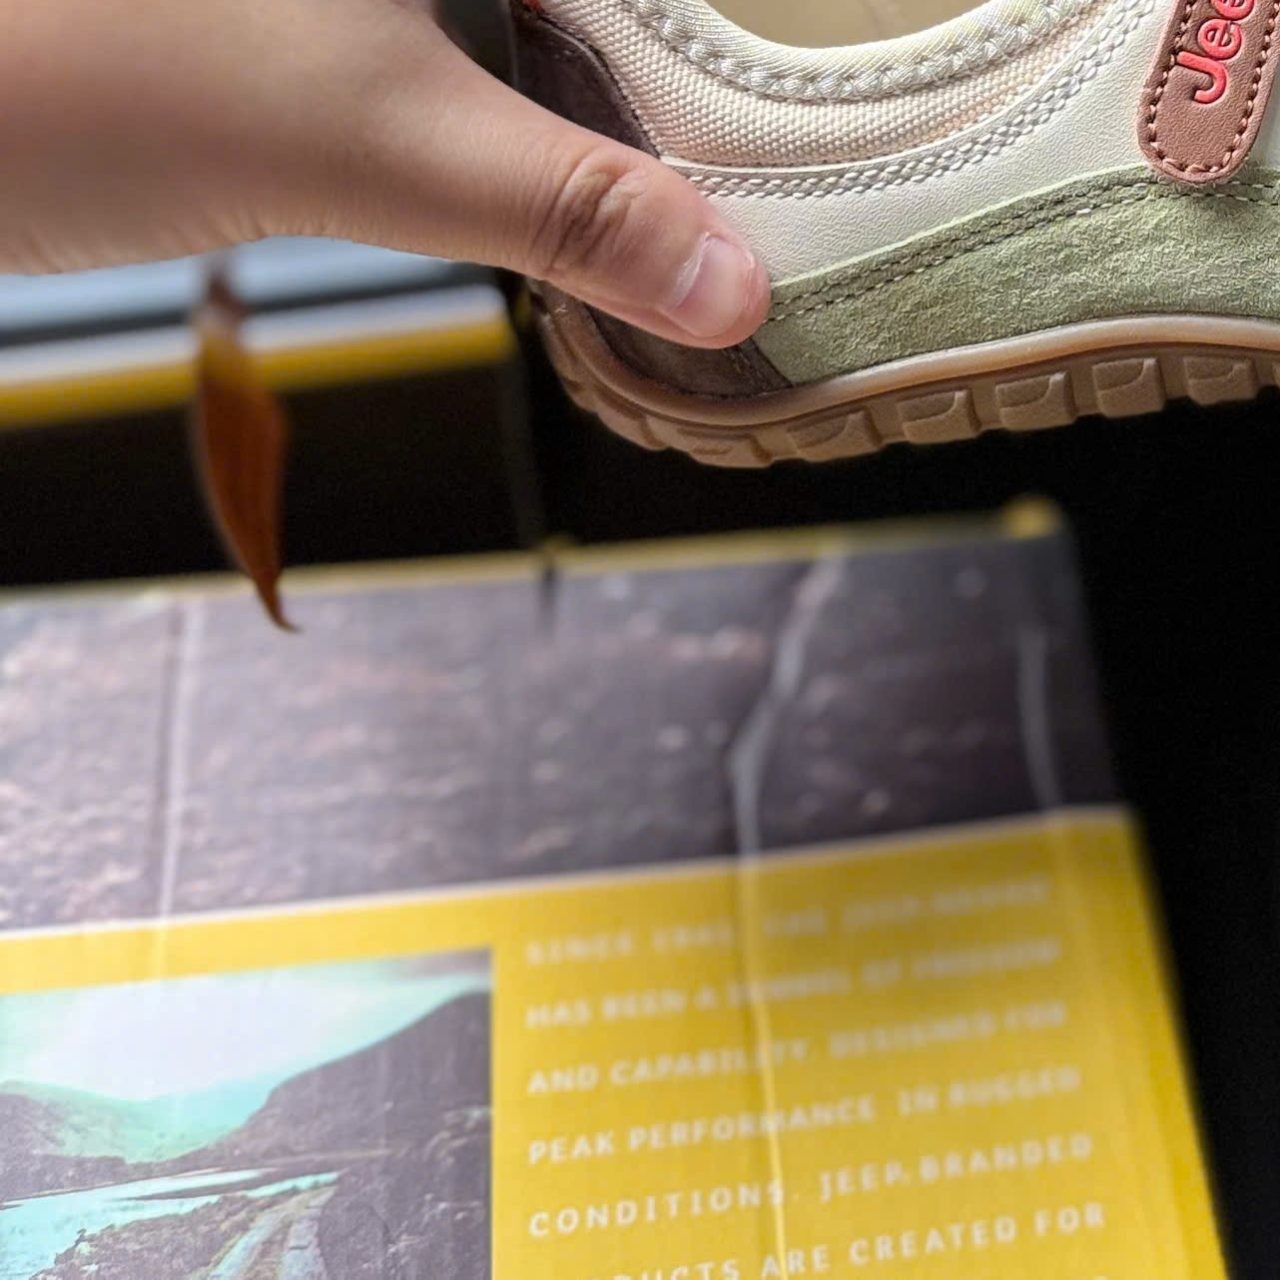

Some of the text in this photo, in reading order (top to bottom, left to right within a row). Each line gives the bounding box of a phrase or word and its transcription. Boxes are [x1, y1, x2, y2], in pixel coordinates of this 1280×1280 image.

[527, 1064, 600, 1095] AND
[529, 1131, 615, 1165] PEAK
[626, 1097, 874, 1150] PERFORMANCE
[761, 1246, 829, 1279] ARE
[850, 1216, 1018, 1267] CREATED
[1034, 1202, 1105, 1234] FOR
